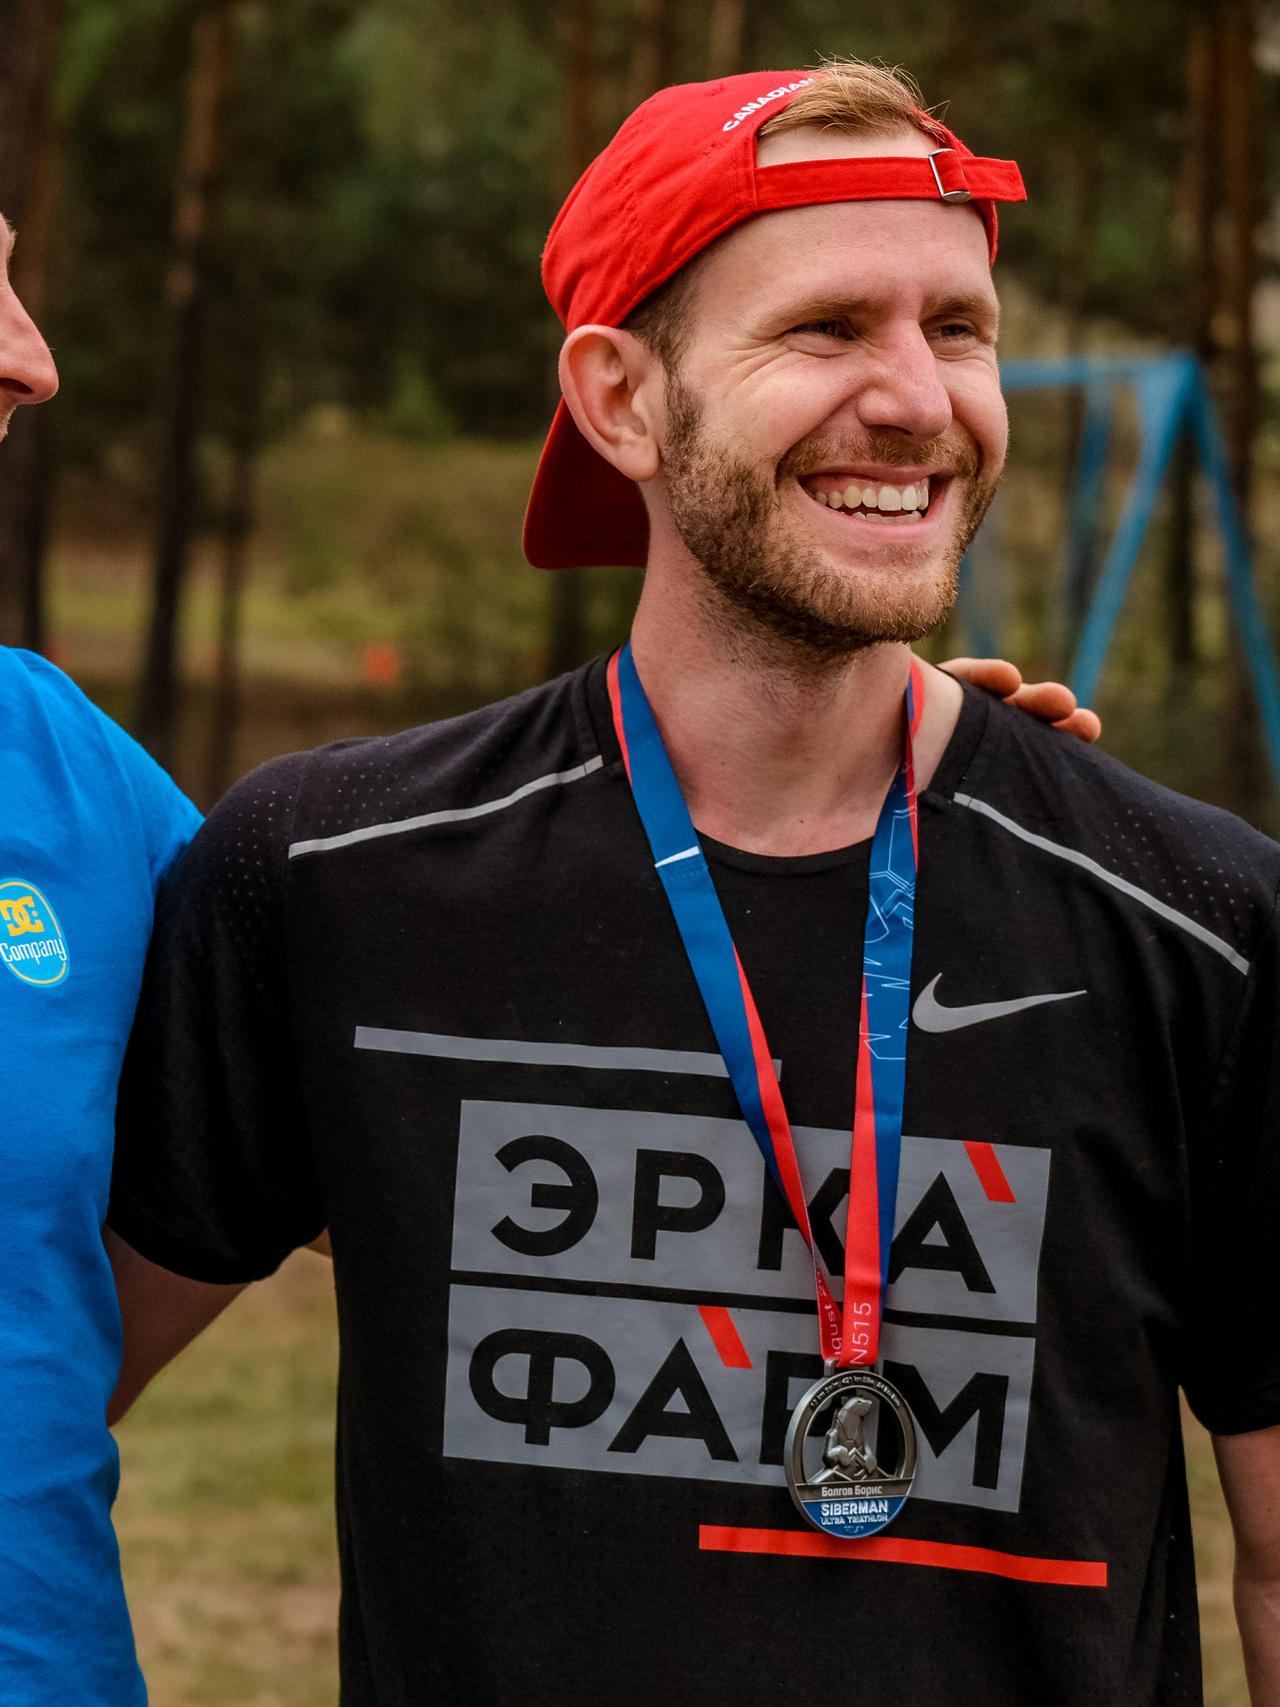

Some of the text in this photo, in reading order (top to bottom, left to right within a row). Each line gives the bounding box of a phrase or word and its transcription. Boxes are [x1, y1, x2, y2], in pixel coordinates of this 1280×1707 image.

[821, 1484, 883, 1498] Болгов Борис
[820, 1500, 889, 1517] SIBERMAN
[821, 1513, 888, 1526] ULTRA TRIATHLON
